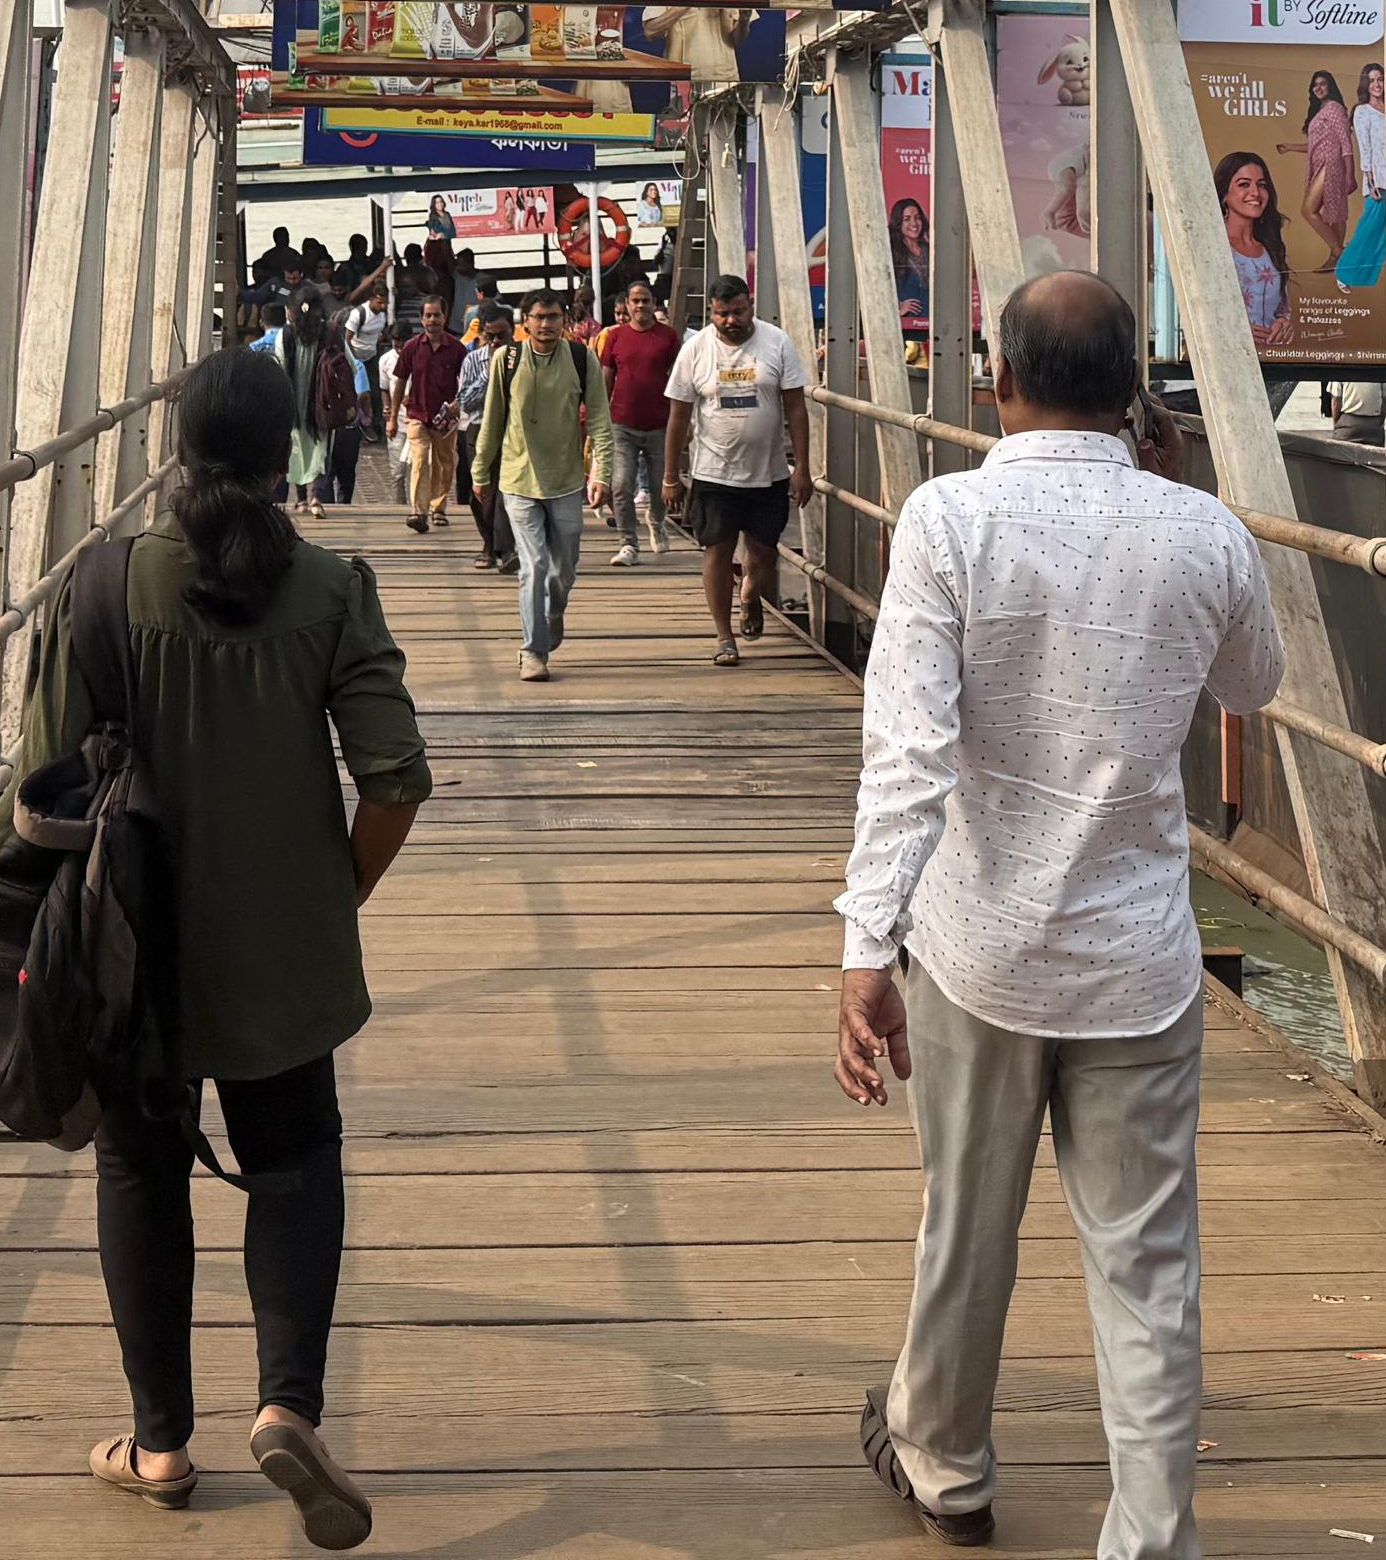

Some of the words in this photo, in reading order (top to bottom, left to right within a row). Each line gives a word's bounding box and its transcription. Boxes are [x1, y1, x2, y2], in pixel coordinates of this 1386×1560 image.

[1284, 0, 1301, 12] BY
[1208, 85, 1236, 99] we
[1240, 80, 1265, 99] all
[1223, 99, 1287, 118] GIRLS
[416, 116, 444, 126] E-mail
[1334, 307, 1371, 317] Leggings
[1305, 349, 1345, 360] Leggings
